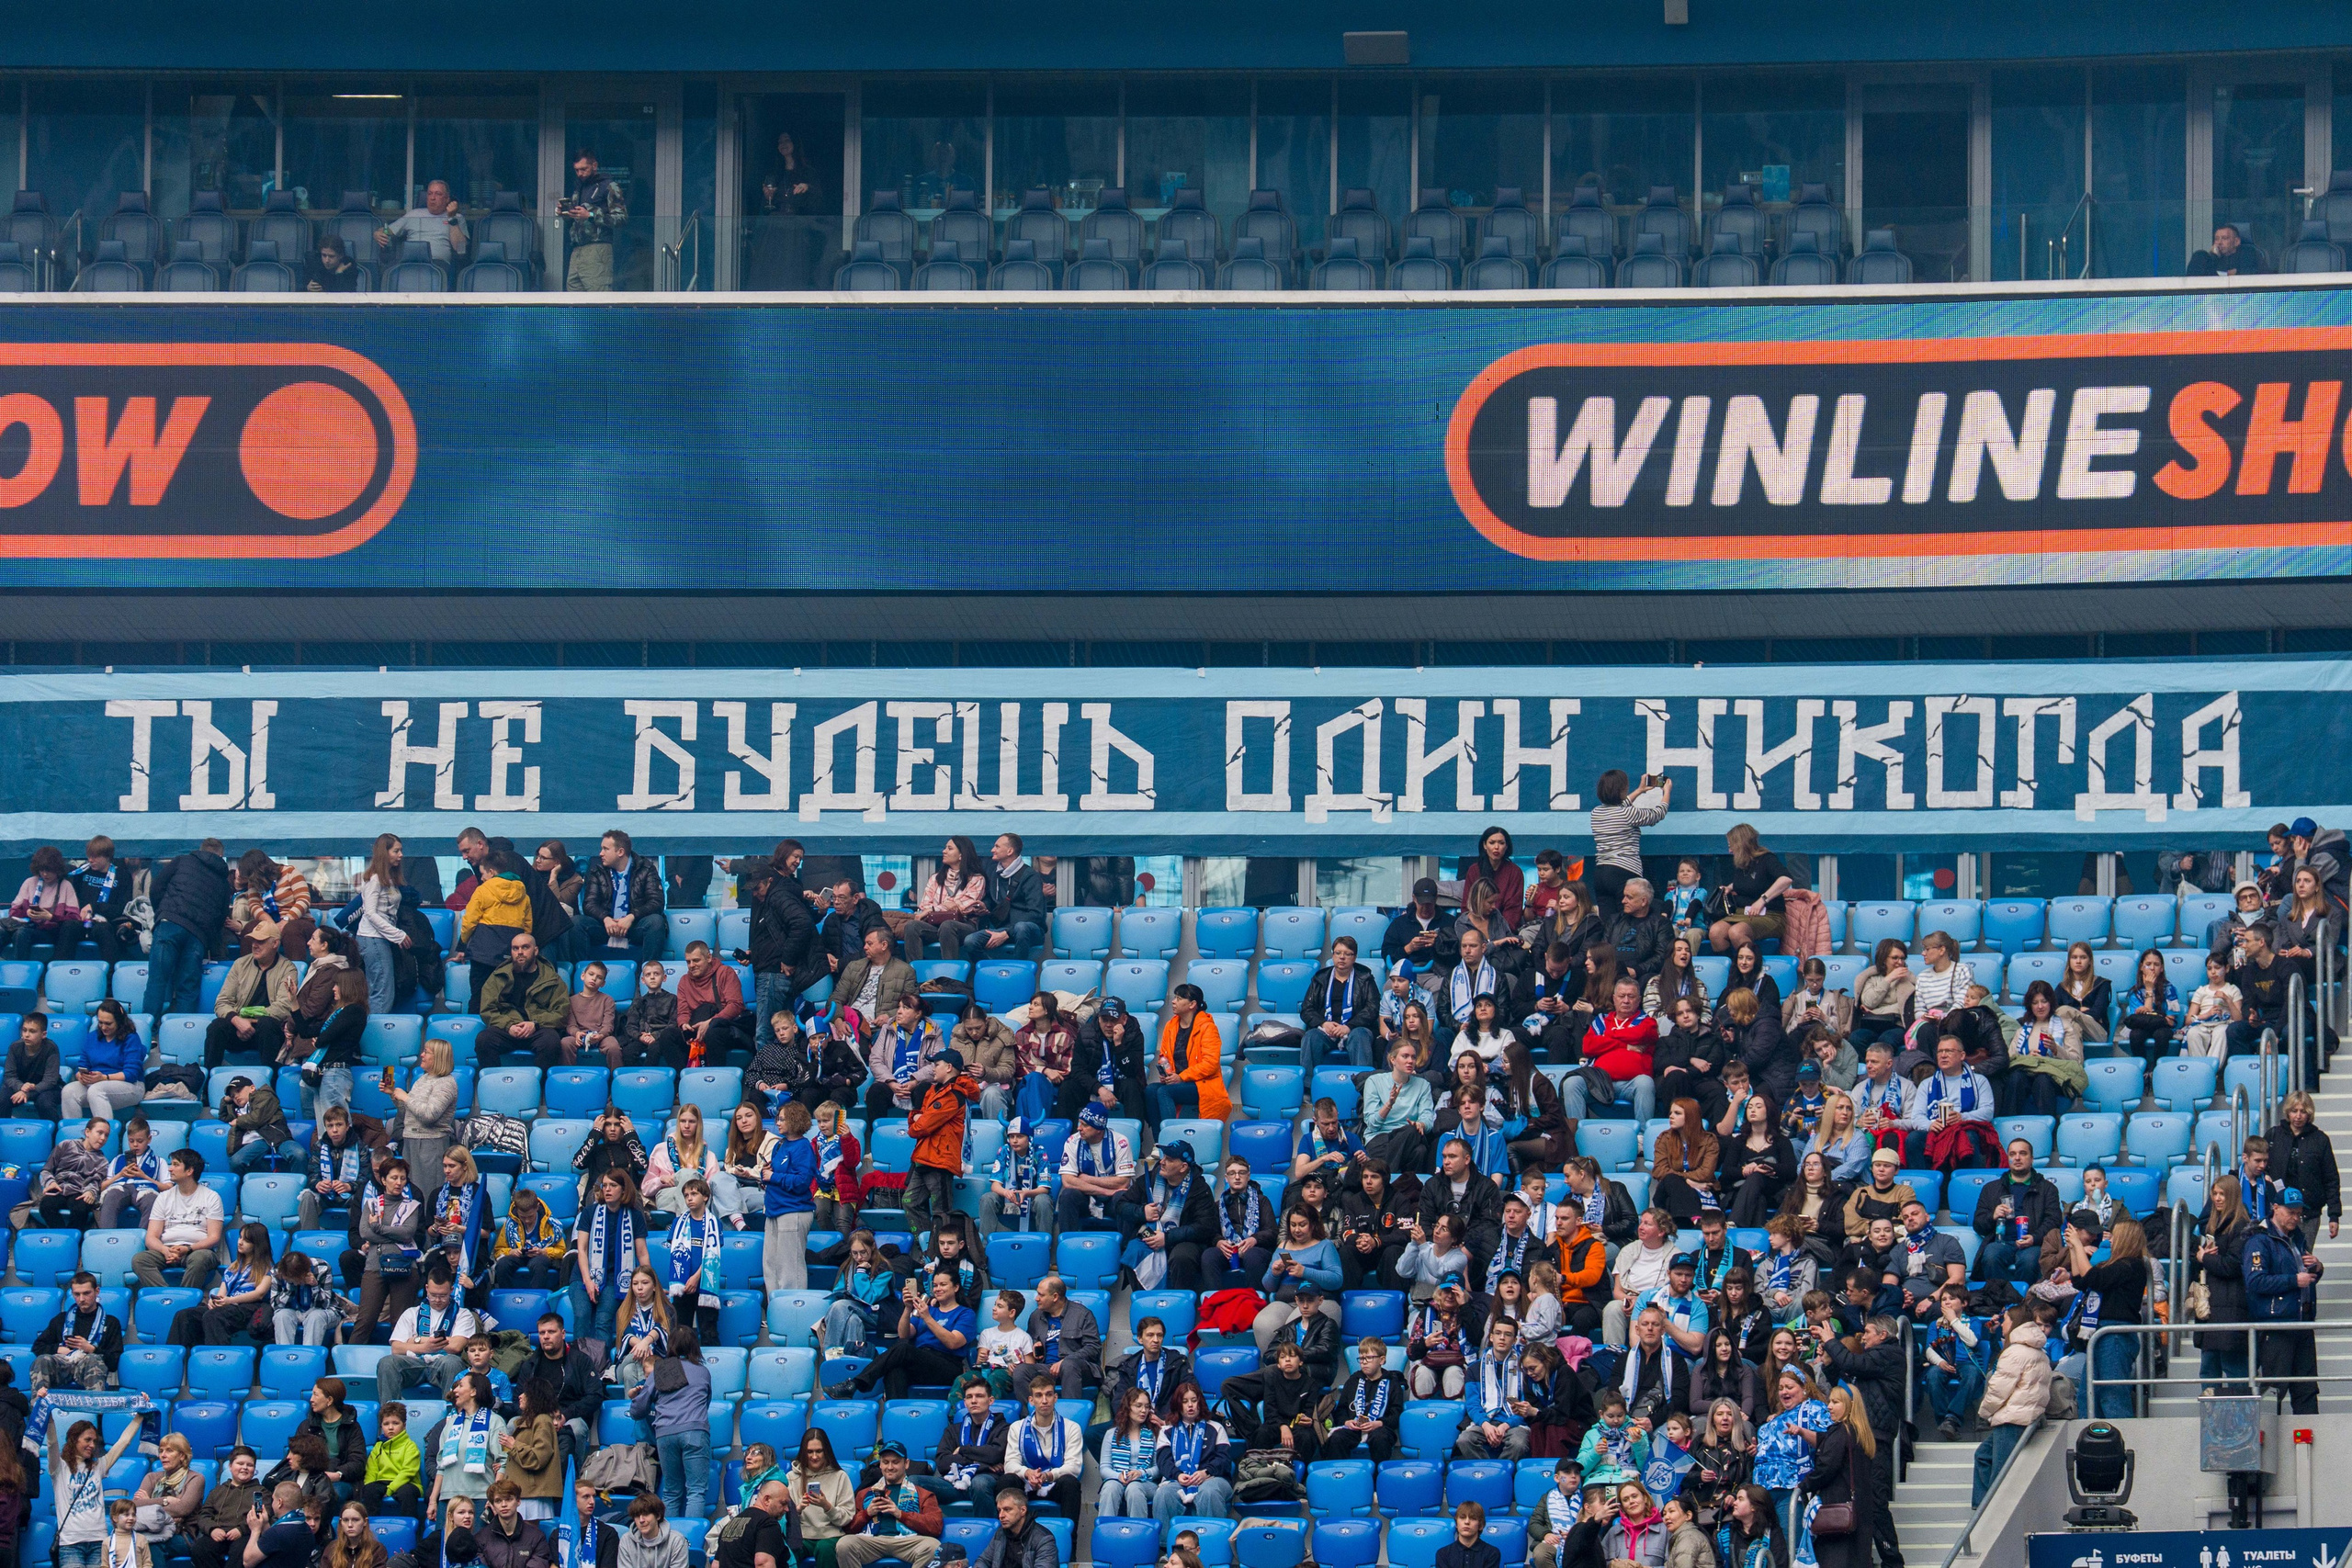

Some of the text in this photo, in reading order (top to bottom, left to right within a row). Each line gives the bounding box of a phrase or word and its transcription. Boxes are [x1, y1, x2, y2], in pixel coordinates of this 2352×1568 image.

[1527, 380, 2352, 509] WINLINE SH
[105, 689, 2251, 824] ТЫ НЕ БУДЕШЬ ОДИН НИКОГДА
[83, 874, 119, 888] ETEMES
[1108, 1010, 1119, 1019] 12
[594, 1206, 605, 1255] ИТЕР!
[84, 1395, 94, 1407] В
[2116, 1552, 2163, 1564] БУФЕТЫ
[2243, 1550, 2296, 1561] ТУАЛЕТЫ
